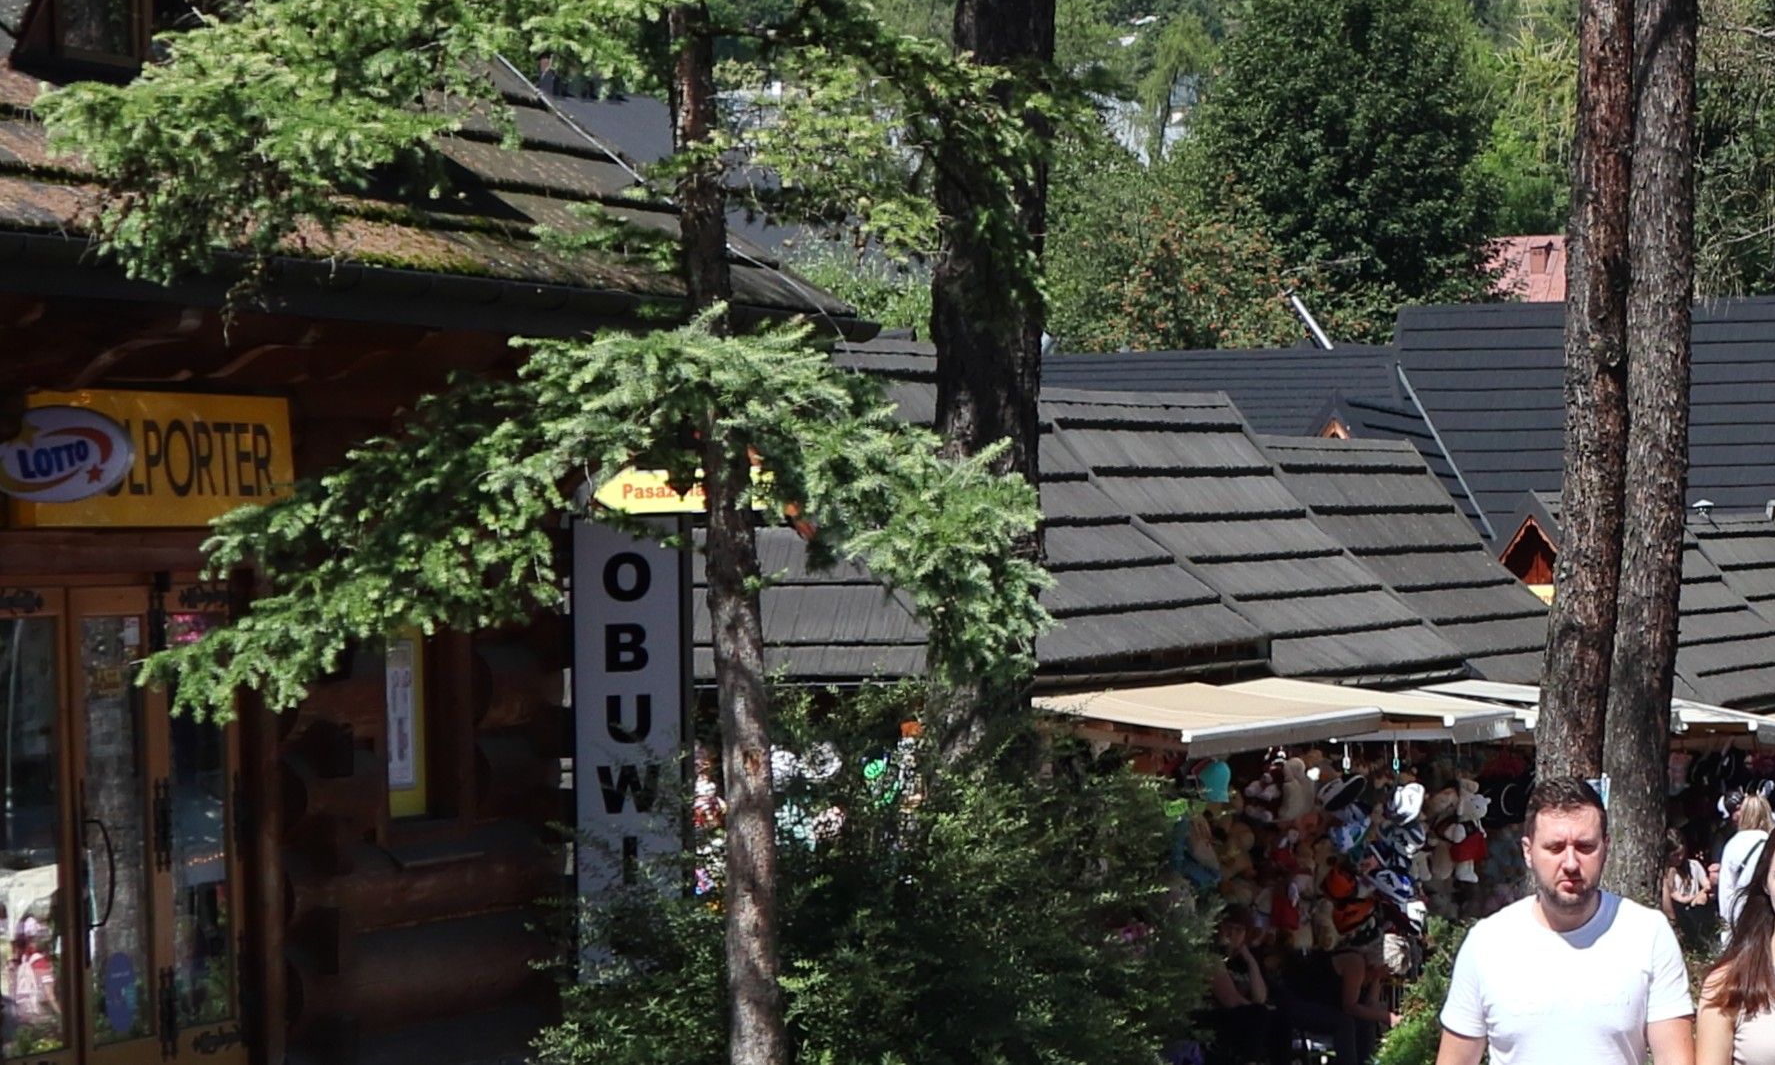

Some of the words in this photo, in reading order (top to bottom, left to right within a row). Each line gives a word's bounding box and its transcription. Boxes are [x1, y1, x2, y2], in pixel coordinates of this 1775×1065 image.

[17, 439, 90, 479] LOTTO
[105, 419, 277, 497] LPORTER
[597, 551, 660, 885] OBUWI
